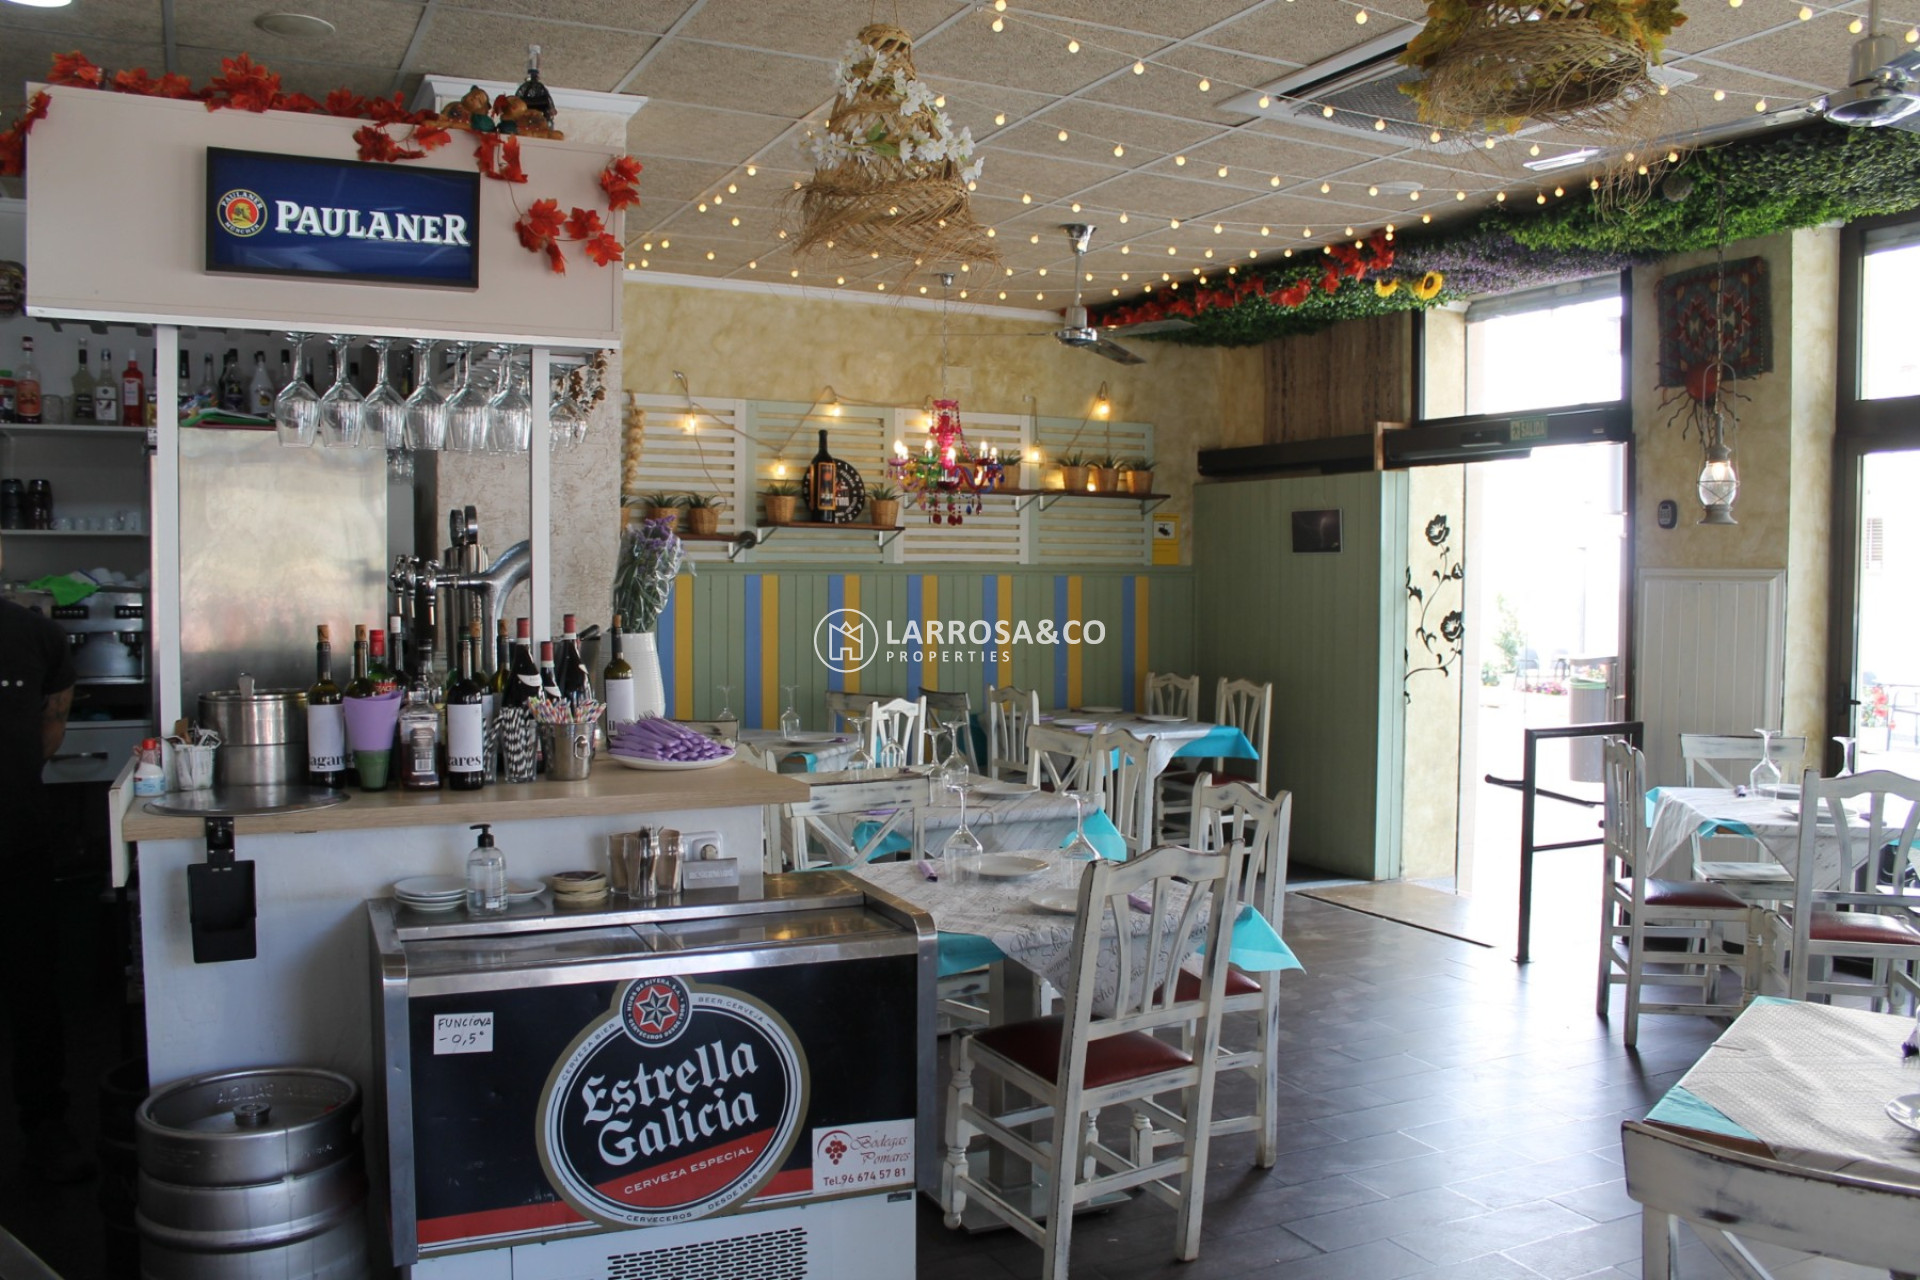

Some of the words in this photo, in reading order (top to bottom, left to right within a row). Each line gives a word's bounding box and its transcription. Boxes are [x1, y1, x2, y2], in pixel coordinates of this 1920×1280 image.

[221, 191, 264, 209] PAULANER
[275, 200, 471, 247] PAULANER
[1521, 420, 1545, 437] SALIDA
[581, 1039, 759, 1126] Estrella
[597, 1087, 760, 1166] Galicia
[850, 1133, 908, 1152] Bodegas
[624, 1167, 687, 1195] CERVEZA
[690, 1146, 754, 1173] ESPECIAL
[860, 1150, 911, 1165] Pomares
[857, 1171, 876, 1182] 674
[879, 1168, 891, 1180] 57
[894, 1167, 906, 1178] 81
[626, 1211, 693, 1223] CERVECEROS
[707, 1191, 740, 1210] DESDE
[739, 1173, 758, 1191] 1906
